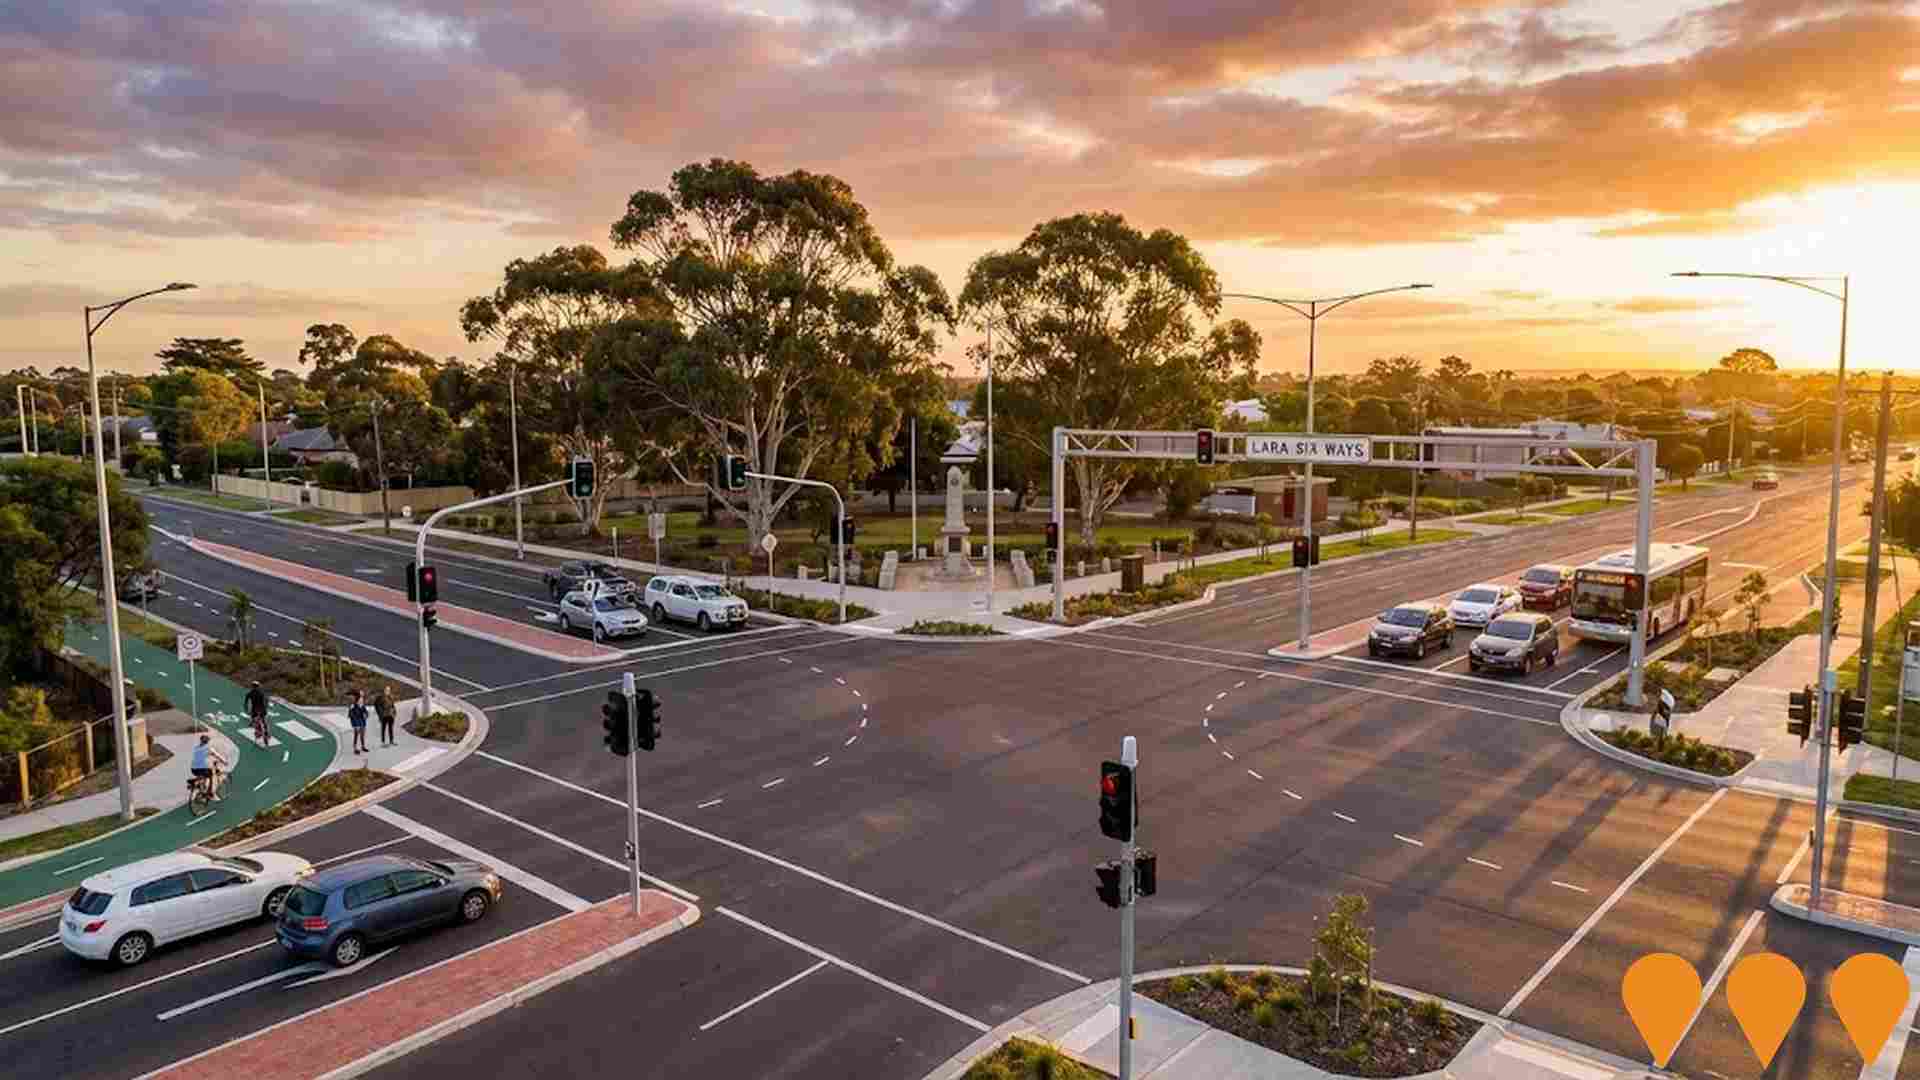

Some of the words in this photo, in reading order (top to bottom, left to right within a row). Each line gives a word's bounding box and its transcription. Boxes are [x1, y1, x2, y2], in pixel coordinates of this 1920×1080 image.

[1252, 441, 1289, 455] LARA
[1296, 442, 1318, 456] SIX
[1325, 442, 1364, 458] WAYS
